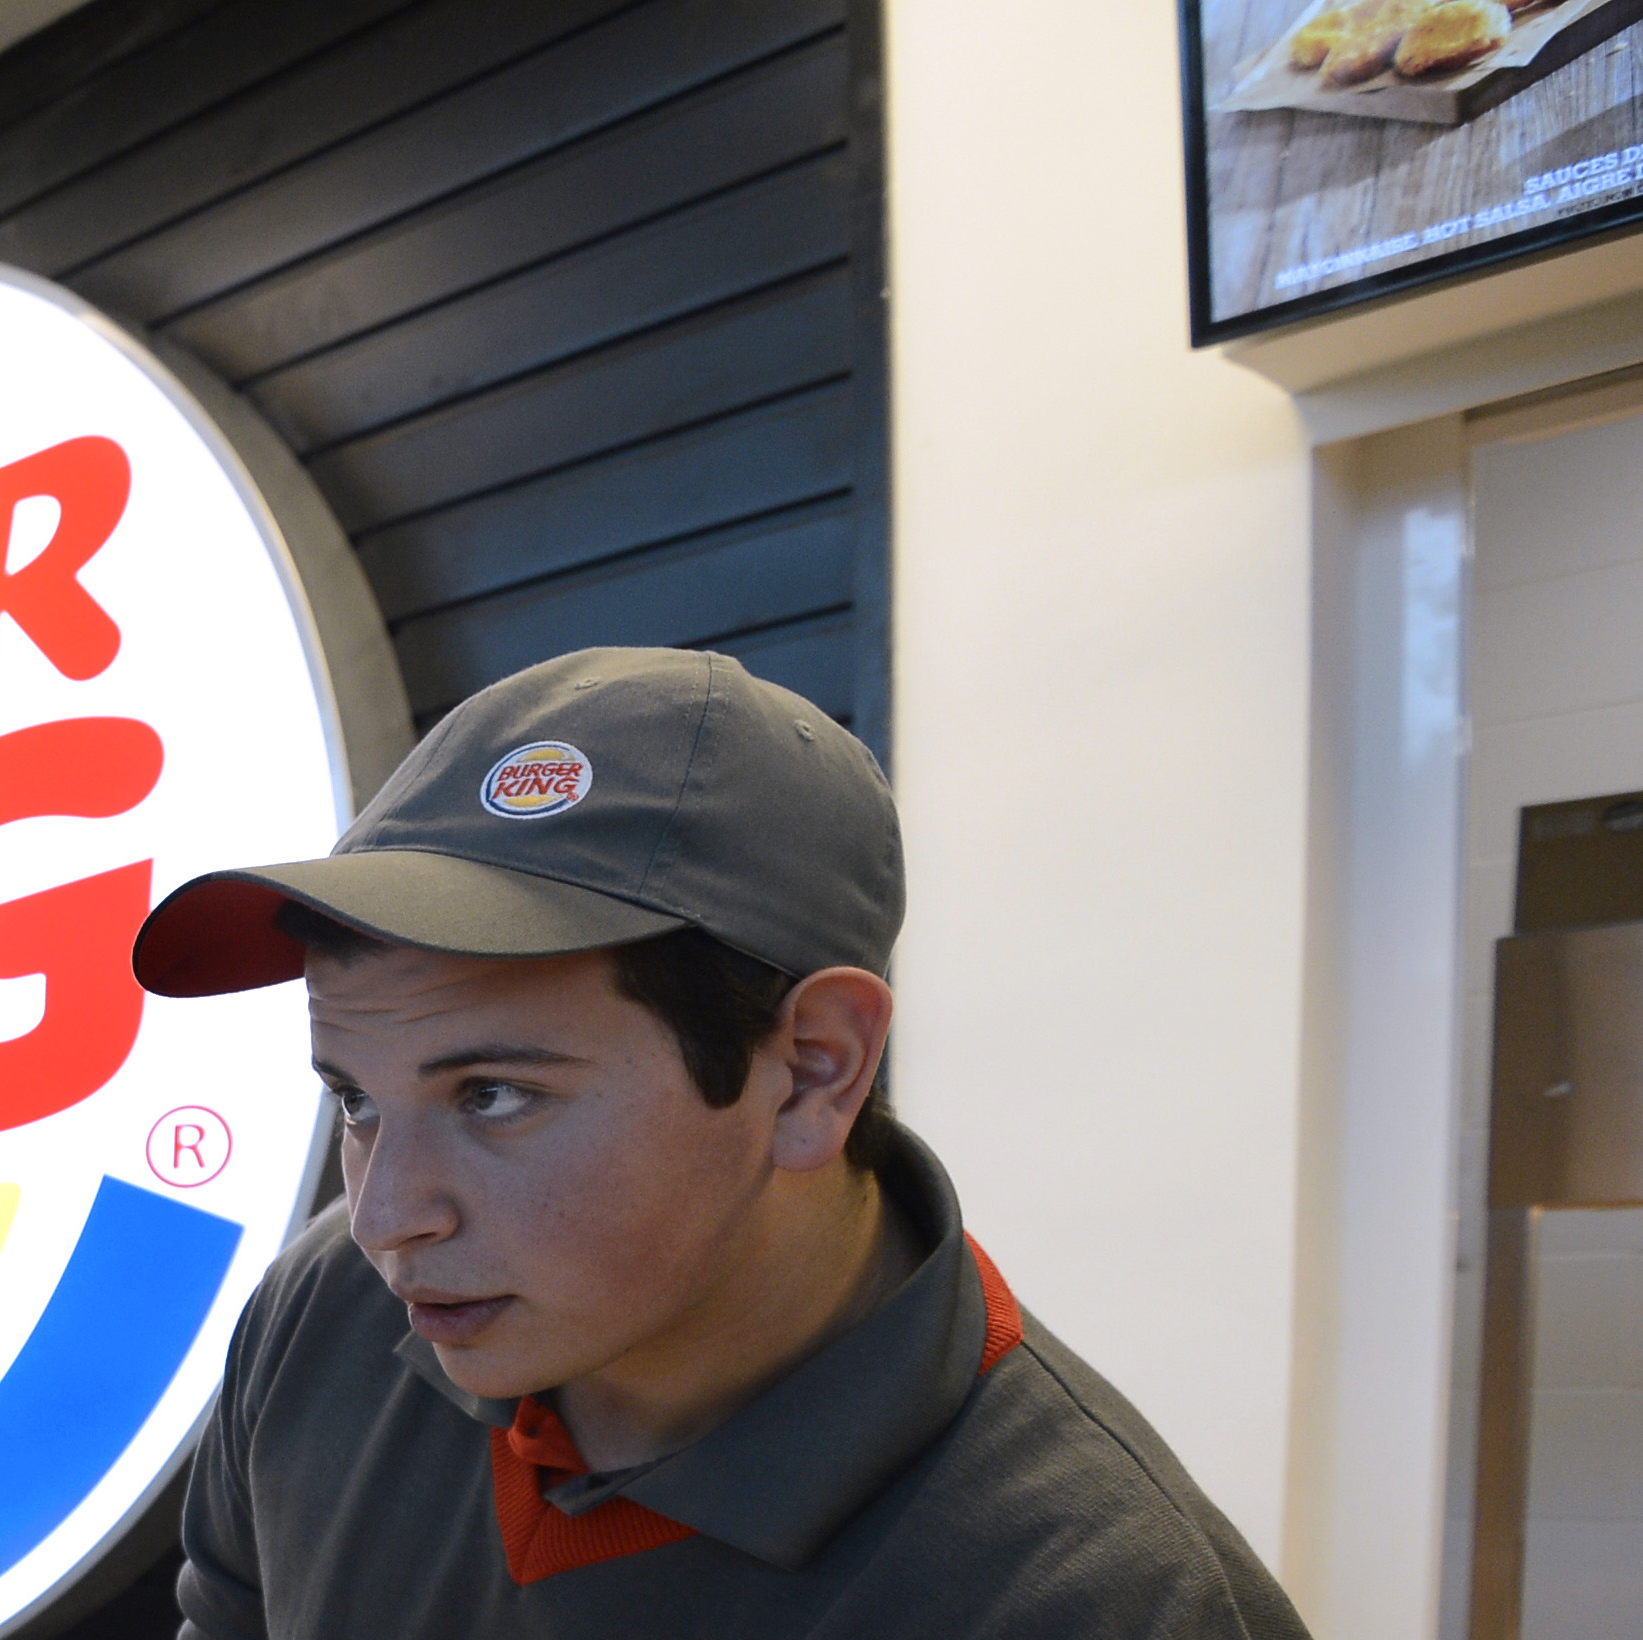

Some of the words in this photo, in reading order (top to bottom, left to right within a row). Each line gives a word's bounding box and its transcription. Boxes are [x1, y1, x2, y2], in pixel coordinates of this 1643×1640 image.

[1524, 151, 1620, 196] SAUCES
[496, 762, 584, 783] BURGER
[491, 777, 580, 801] KING
